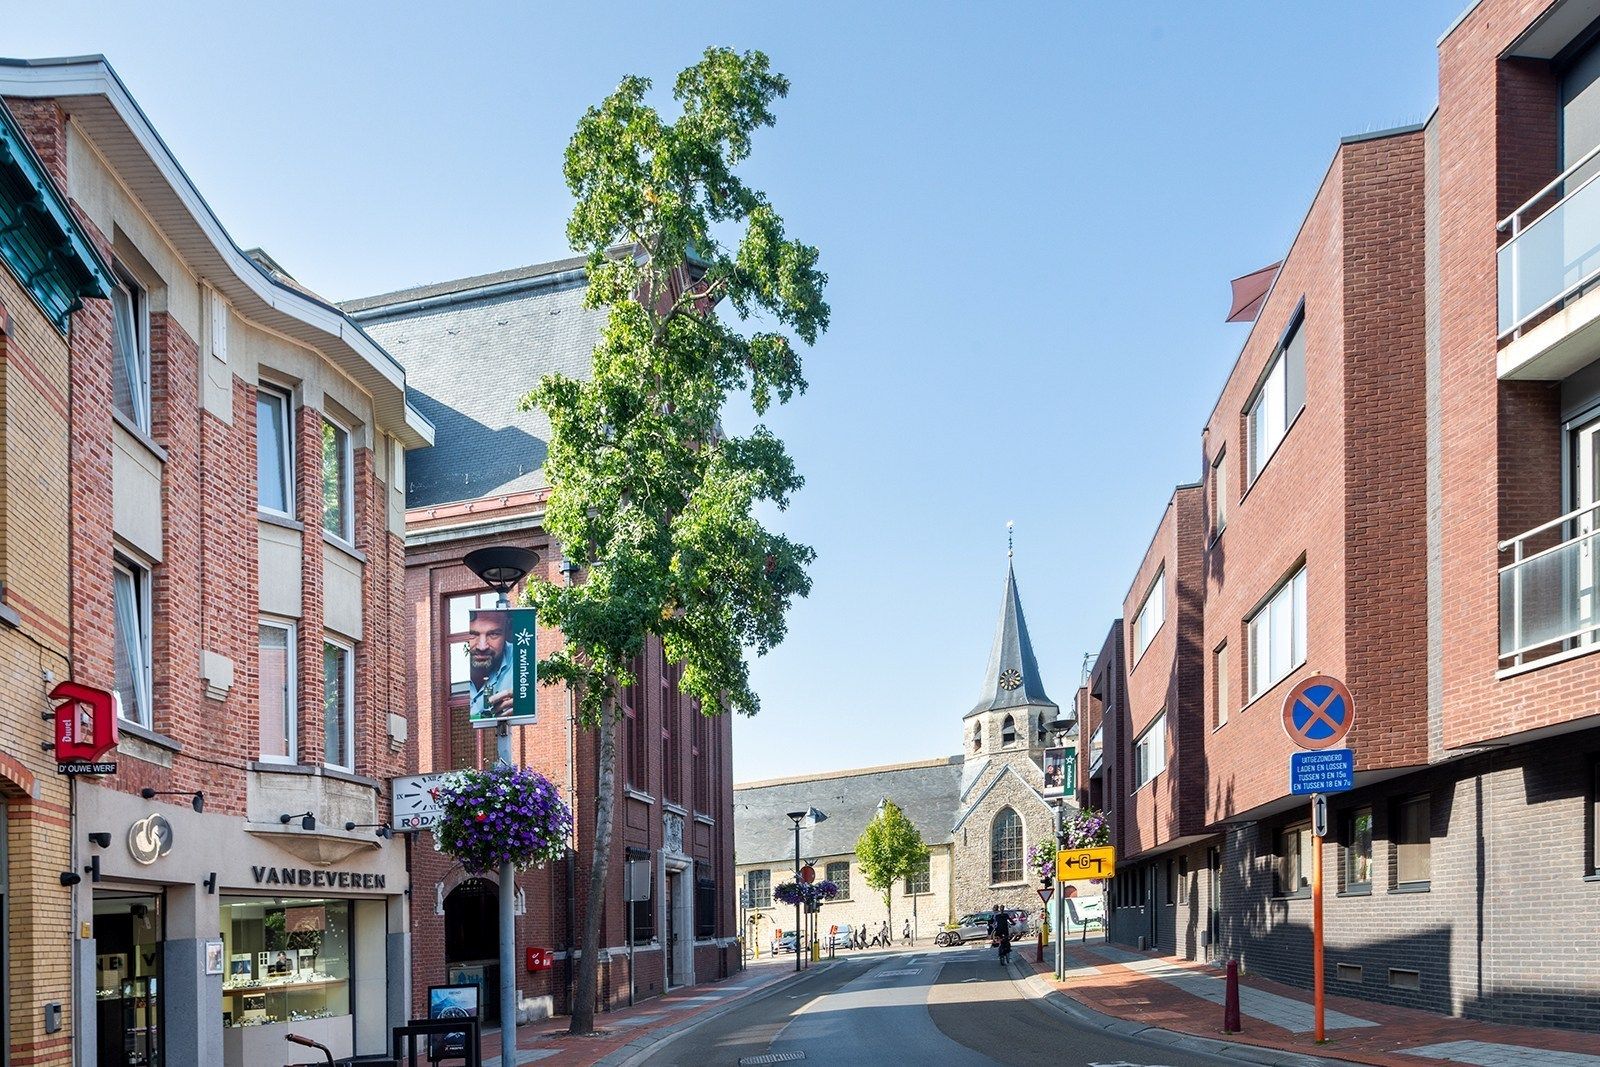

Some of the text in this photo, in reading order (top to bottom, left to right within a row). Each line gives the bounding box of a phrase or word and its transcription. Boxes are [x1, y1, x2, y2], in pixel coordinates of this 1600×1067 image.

[519, 649, 529, 699] zwinkelen
[61, 719, 72, 743] Duvel
[1301, 754, 1343, 764] UITGEZONDERD
[68, 765, 92, 773] OUWE
[93, 764, 116, 772] WERF
[1297, 763, 1347, 773] LADEN EN LOSSEN
[1298, 773, 1320, 781] TUSSEN
[1293, 783, 1302, 791] EN
[1303, 782, 1325, 790] TUSSEN
[1081, 857, 1088, 867] G
[252, 866, 386, 889] VANBEVEREN
